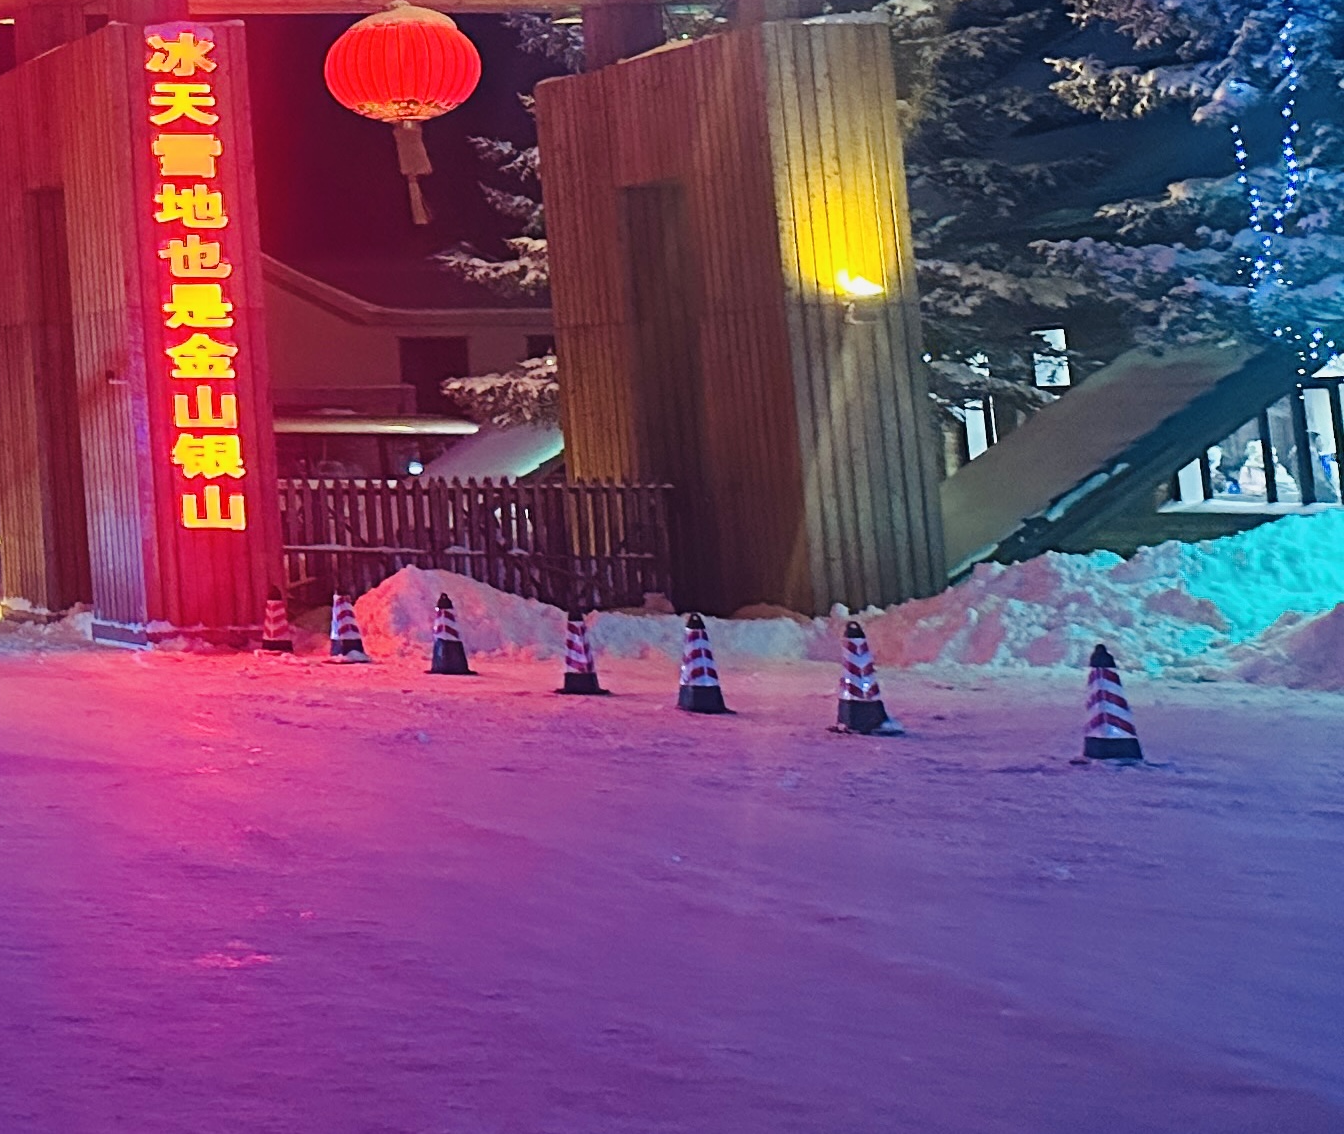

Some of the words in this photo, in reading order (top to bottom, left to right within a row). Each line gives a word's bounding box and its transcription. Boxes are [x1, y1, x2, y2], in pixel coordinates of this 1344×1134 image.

[145, 32, 247, 531] 冰天雪地也是金山银山
